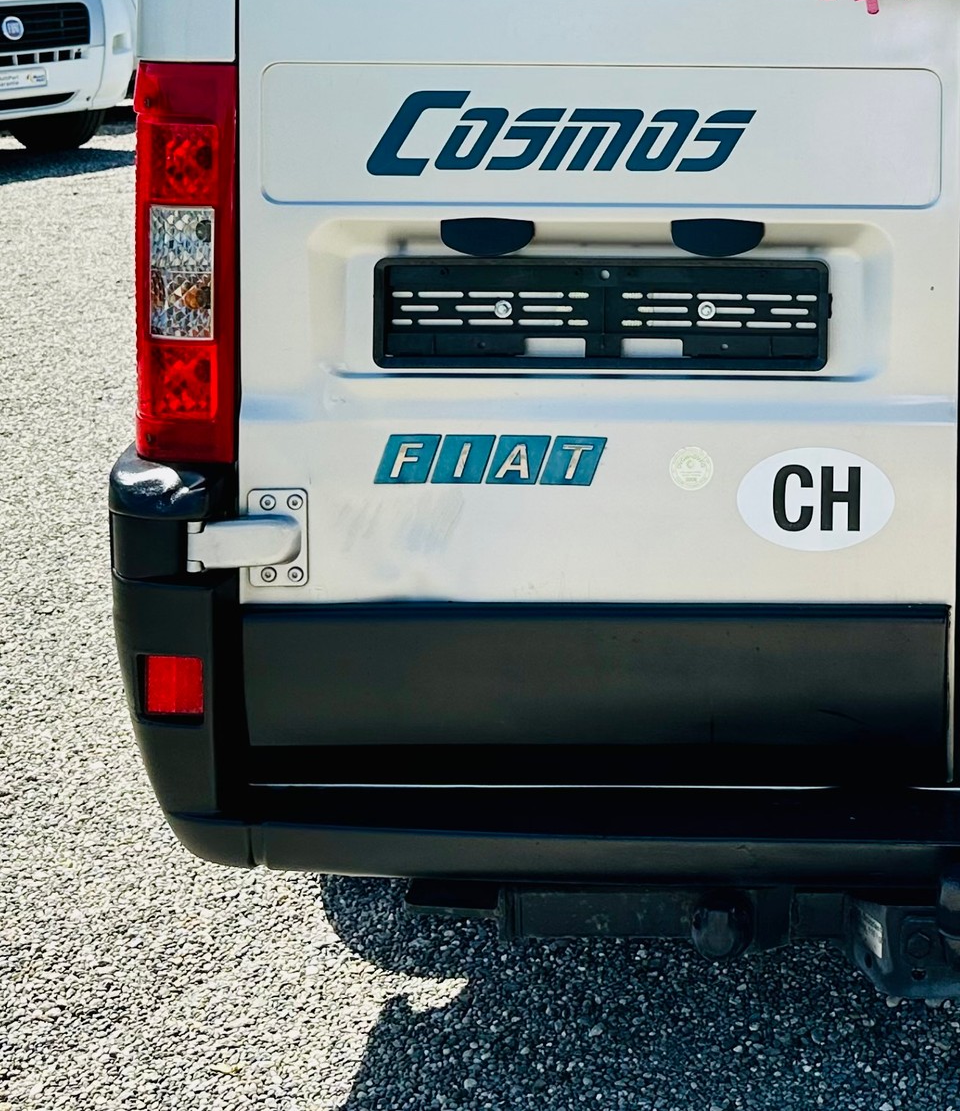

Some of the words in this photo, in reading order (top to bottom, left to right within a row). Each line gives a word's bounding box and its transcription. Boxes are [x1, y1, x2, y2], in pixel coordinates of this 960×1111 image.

[366, 90, 757, 177] Cosmos
[390, 442, 594, 479] FIAT
[772, 463, 862, 533] CH
